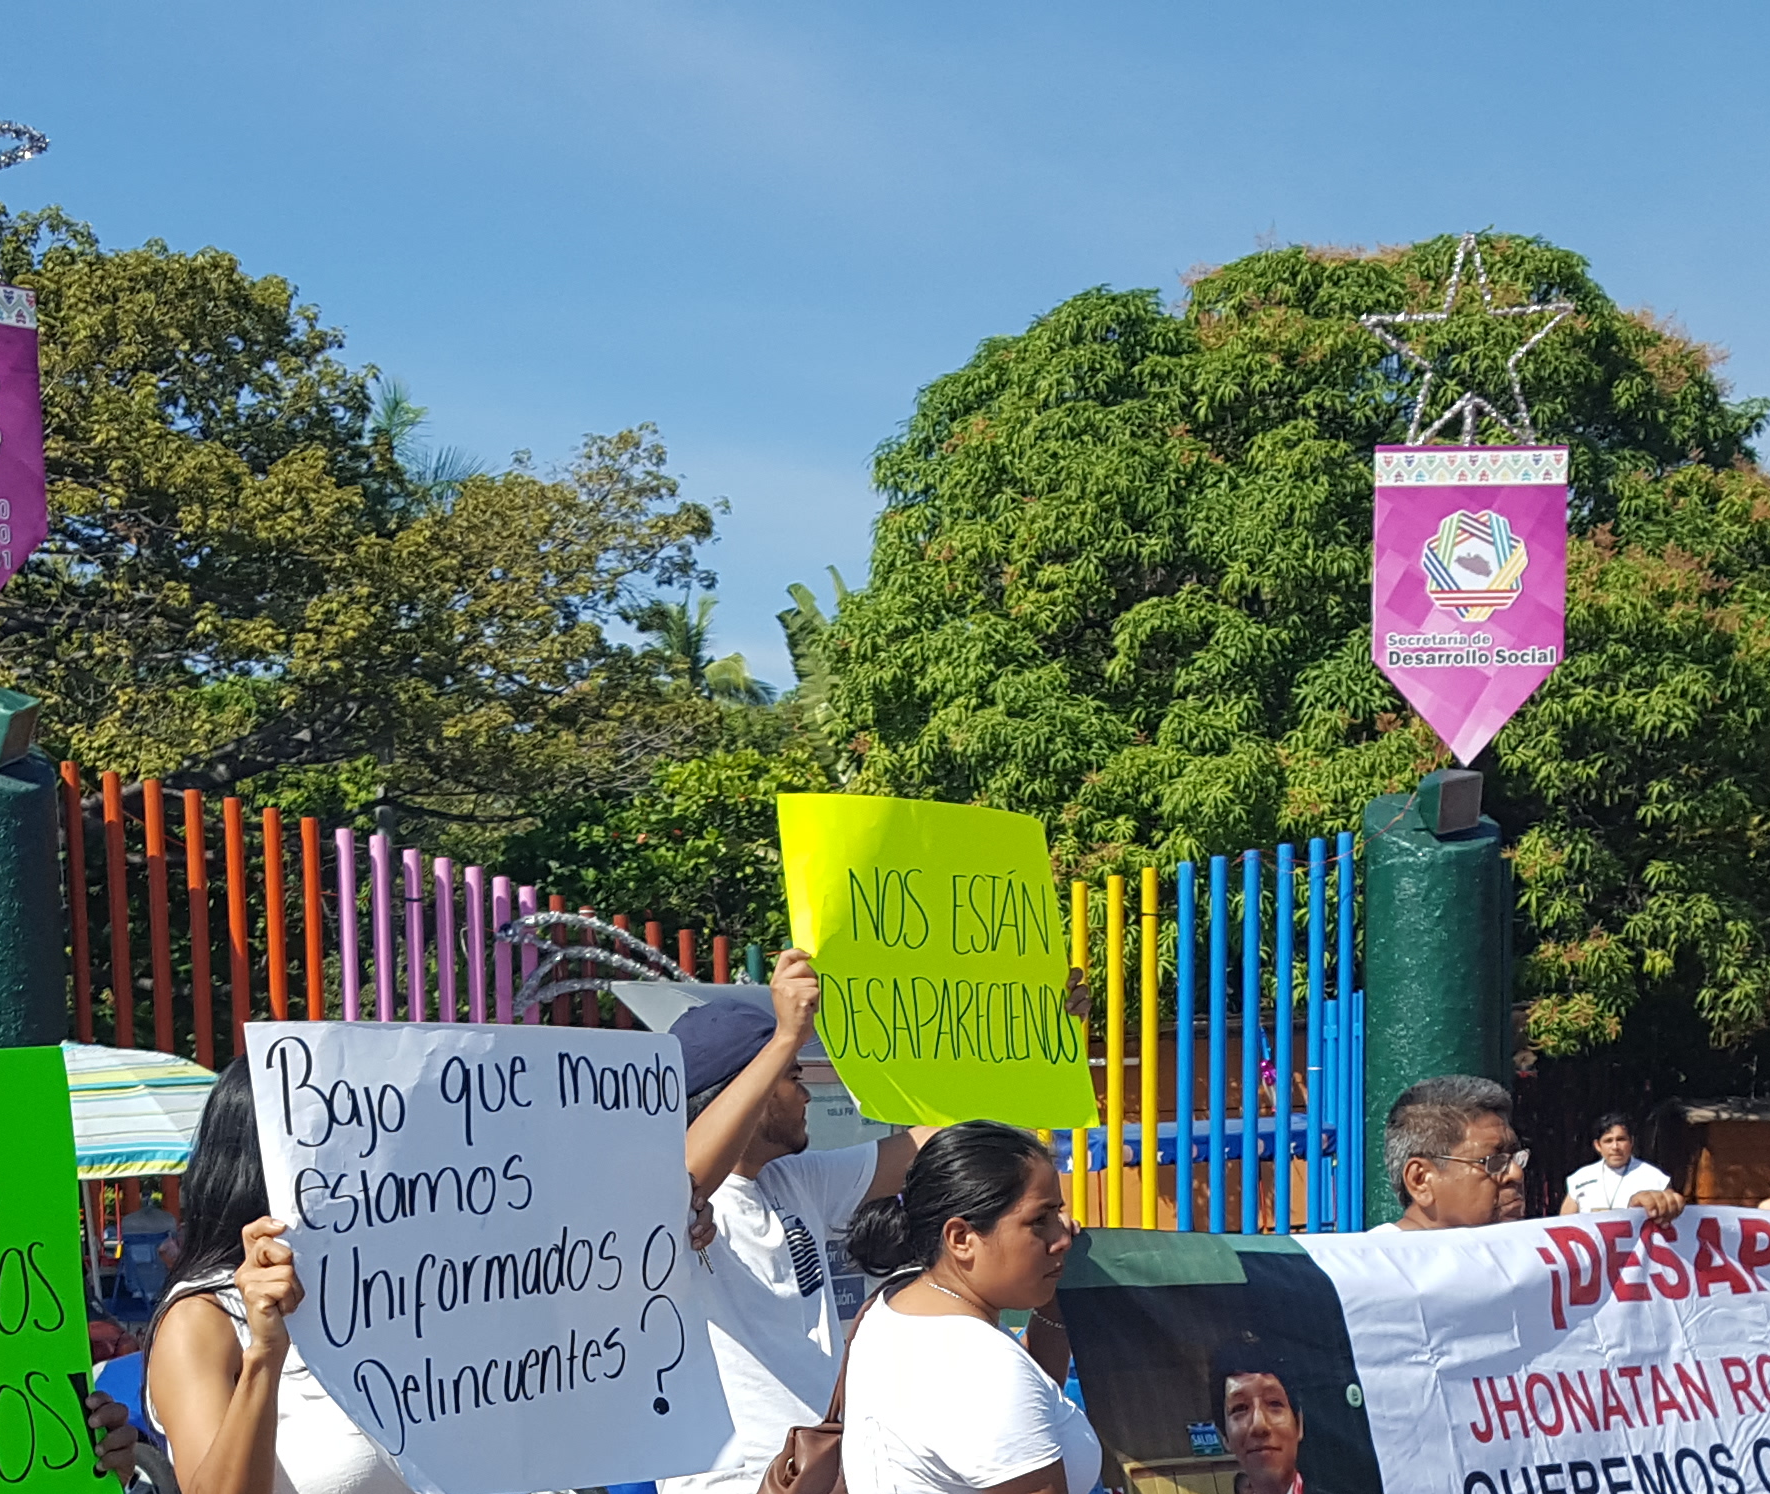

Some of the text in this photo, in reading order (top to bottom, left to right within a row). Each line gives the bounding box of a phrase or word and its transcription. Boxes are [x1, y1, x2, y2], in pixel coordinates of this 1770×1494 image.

[1387, 631, 1492, 647] Secretaría de
[1388, 648, 1556, 666] Desarrollo Social
[849, 867, 1050, 957] NOS ESTÁN
[821, 973, 1079, 1064] DESAPARECIENDO
[266, 1035, 406, 1158] Bajo
[440, 1053, 532, 1146] que
[294, 1154, 532, 1233] estamos
[319, 1226, 623, 1348] Uniformados
[1469, 1361, 1717, 1443] JHONATAN
